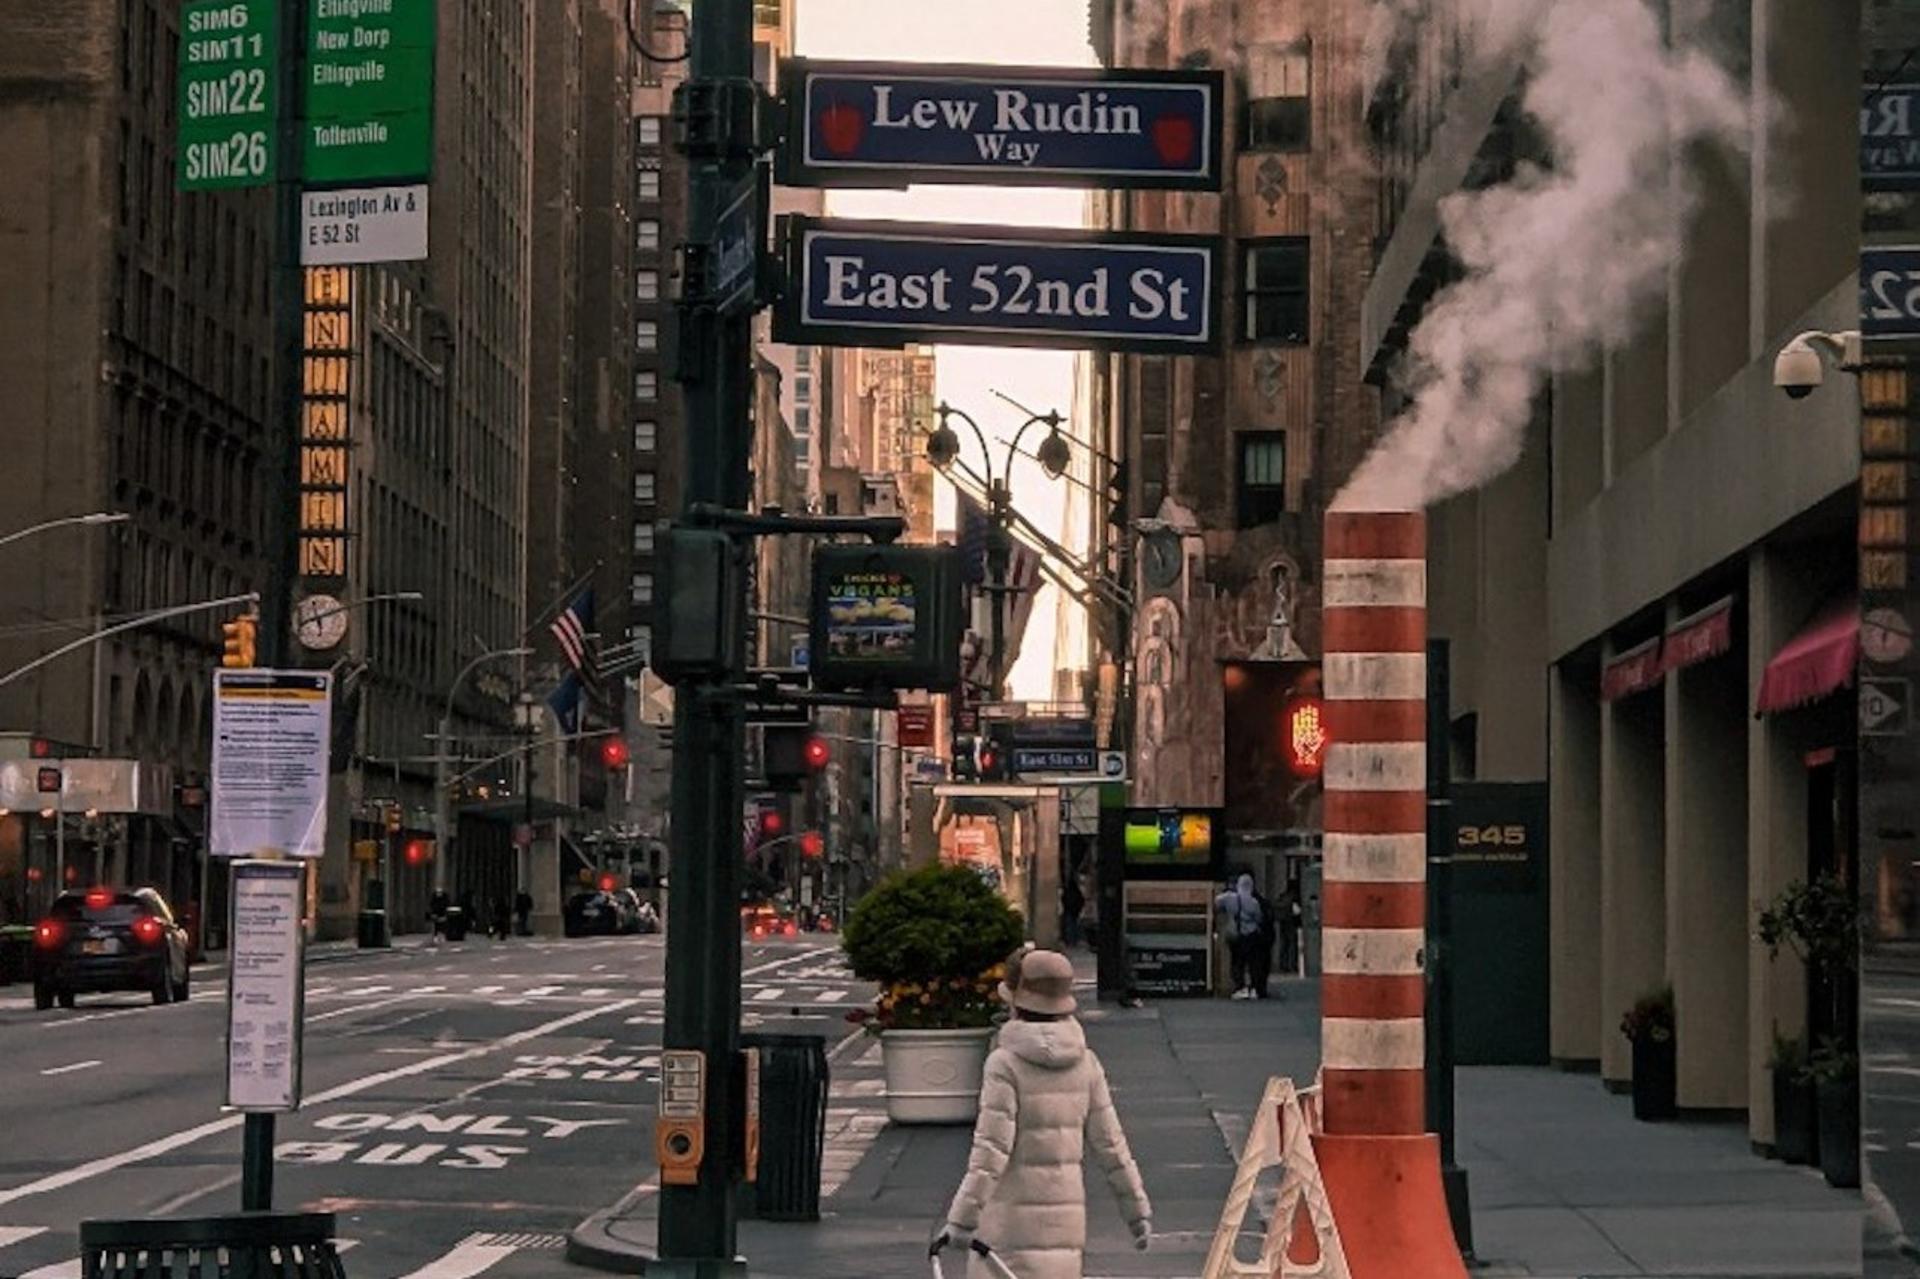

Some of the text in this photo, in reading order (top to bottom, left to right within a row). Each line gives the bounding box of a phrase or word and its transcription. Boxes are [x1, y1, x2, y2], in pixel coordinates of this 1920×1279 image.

[188, 5, 248, 32] SIM6
[188, 34, 263, 62] SIM11
[316, 26, 391, 50] New Dorp
[187, 69, 265, 119] SIM22
[872, 85, 1142, 136] Lew Rudin
[186, 131, 267, 181] SIM26
[974, 133, 1040, 167] Way
[309, 191, 416, 219] Lexington Av &
[309, 223, 360, 245] E 52 St
[823, 255, 1190, 322] East 52nd St
[1457, 826, 1526, 845] 345
[513, 1055, 661, 1068] ONL
[313, 1113, 631, 1138] ONLY
[273, 1141, 530, 1169] BUS
